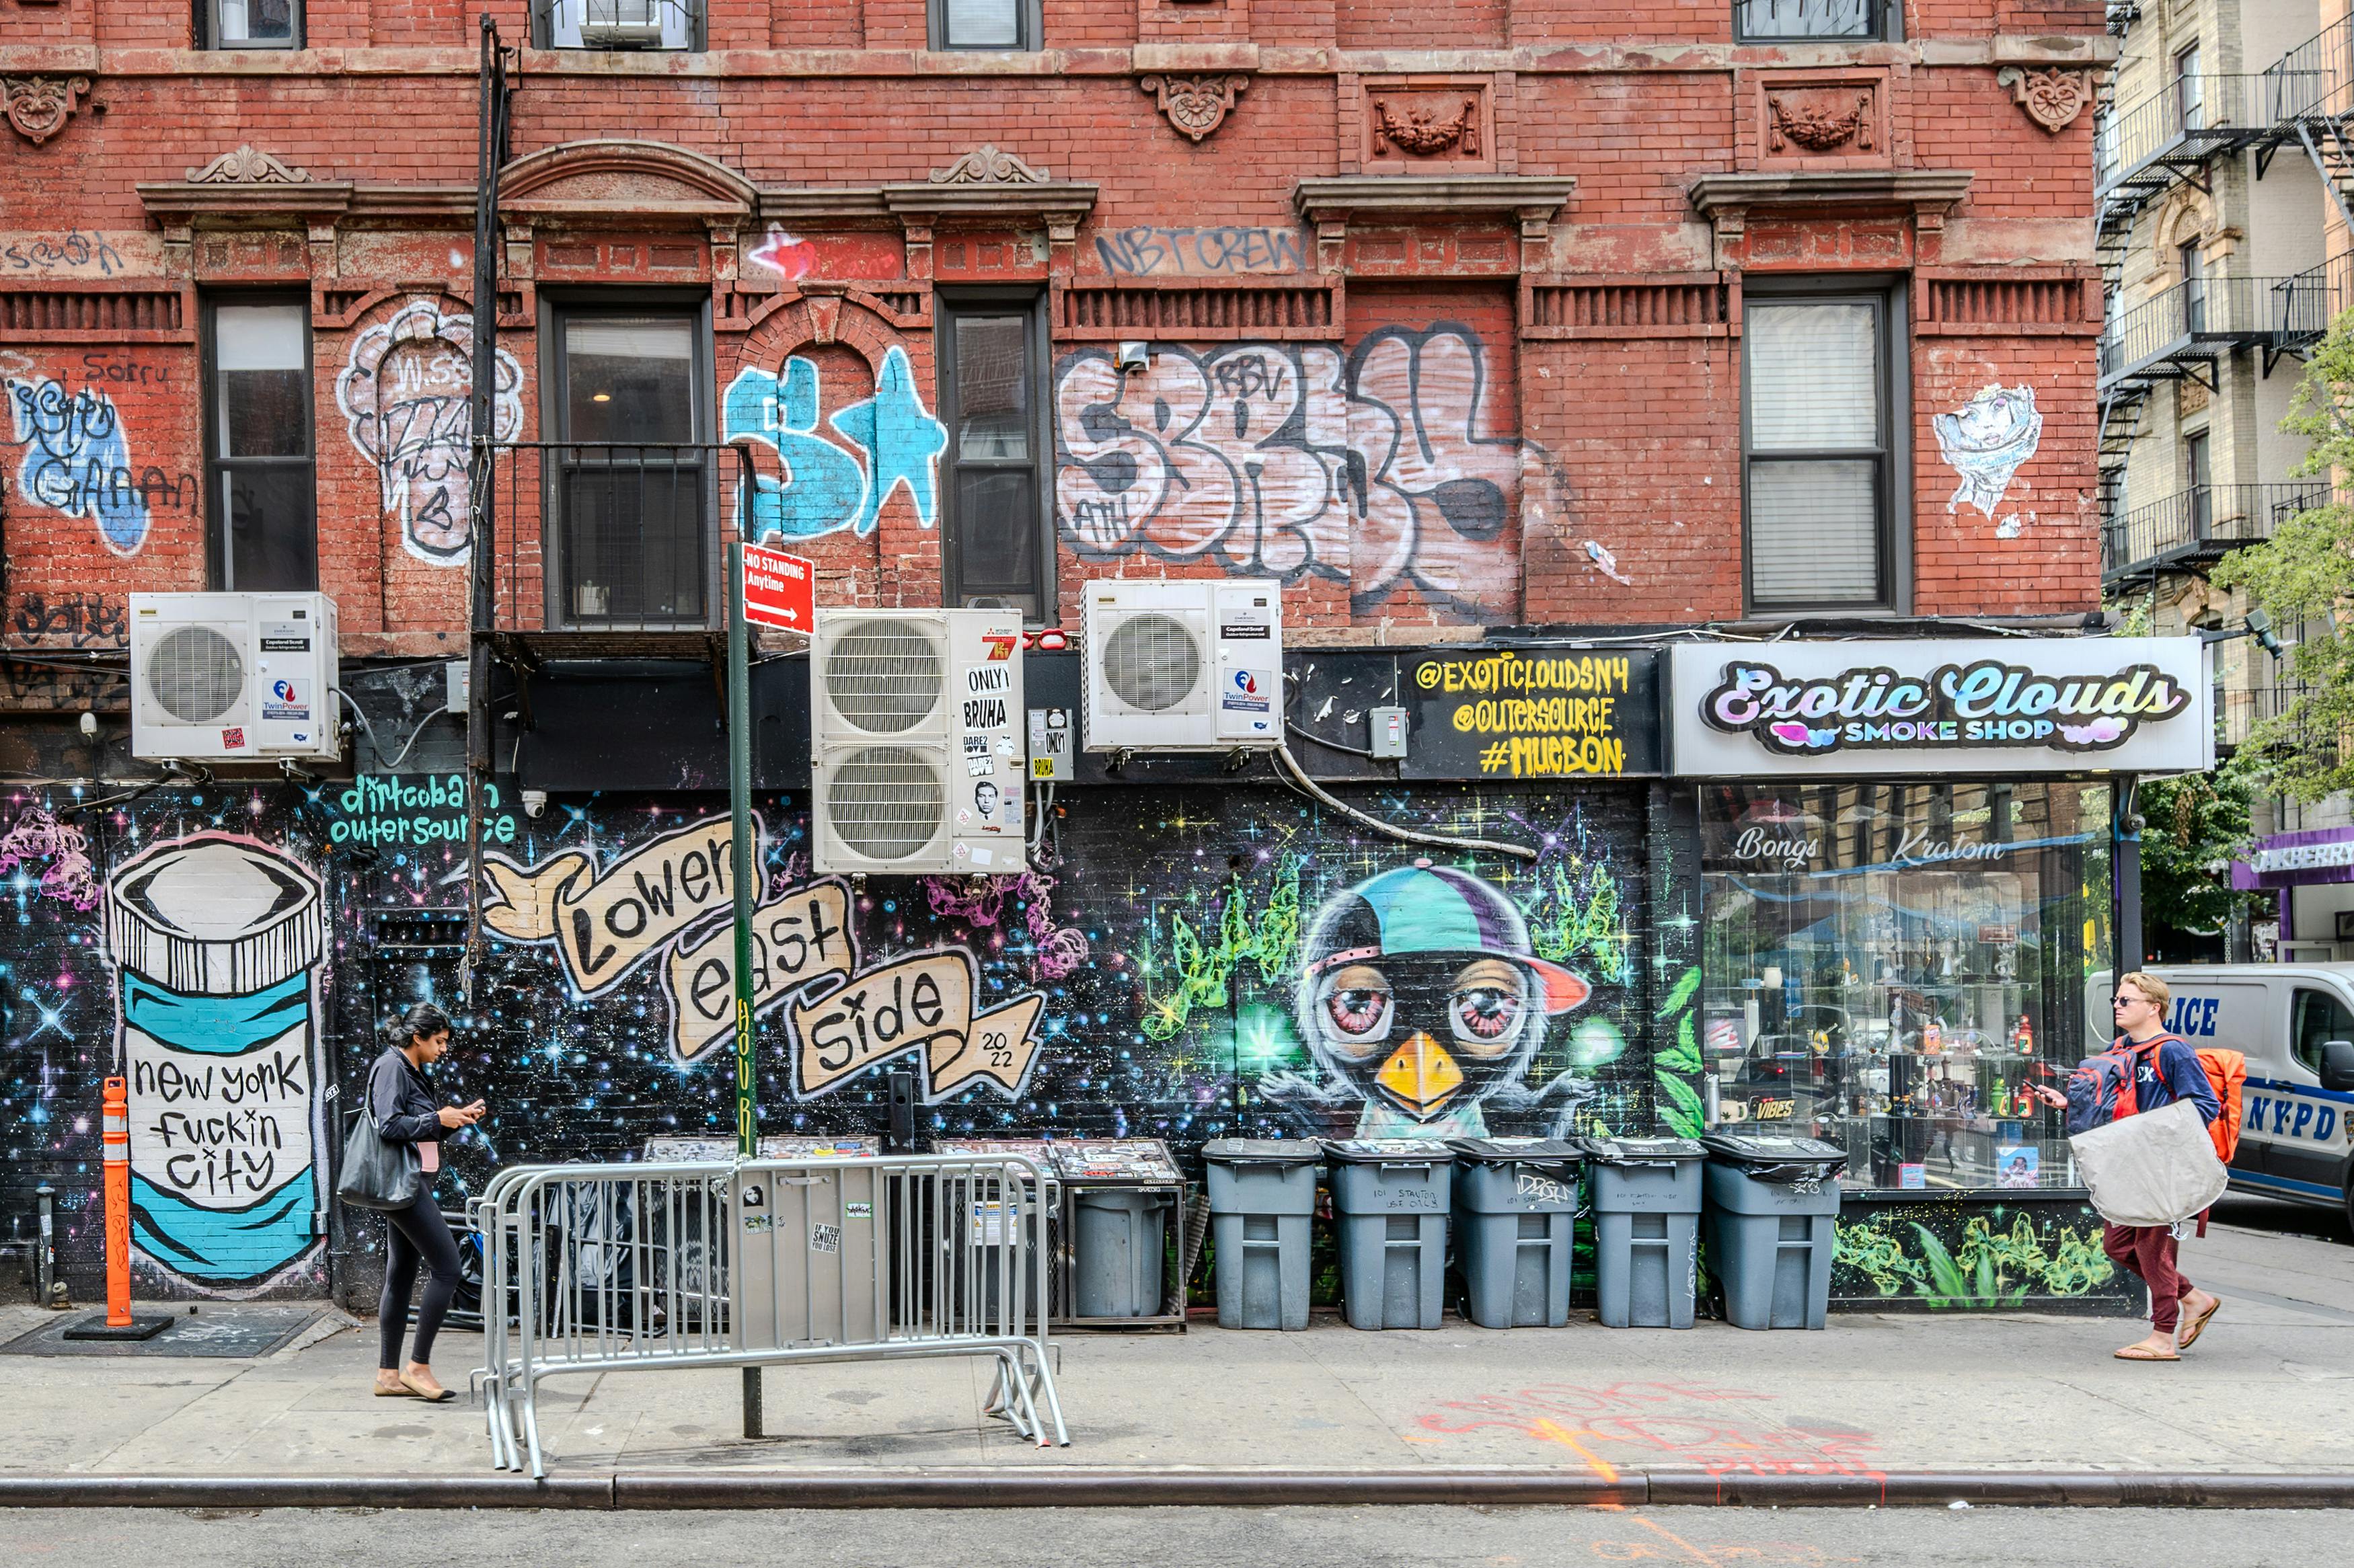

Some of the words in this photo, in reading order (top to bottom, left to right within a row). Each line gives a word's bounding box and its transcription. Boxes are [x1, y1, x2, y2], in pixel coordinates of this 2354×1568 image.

[1096, 224, 1195, 276] NBT
[1195, 229, 1307, 274] CREW
[746, 553, 760, 569] NO
[761, 557, 804, 580] STANDING
[747, 571, 785, 592] Anytime
[264, 702, 308, 710] TwinPower
[1225, 692, 1269, 702] TwinPower
[1715, 666, 1930, 724] Exotic
[1940, 666, 2183, 718] Clouds
[963, 699, 1007, 729] BRUHA
[963, 736, 988, 745] DARE2
[1844, 719, 1958, 741] SMOKE
[1965, 719, 2054, 740] SHOP
[967, 755, 993, 768] DARE2
[1034, 758, 1054, 776] BRUHA
[340, 774, 499, 815] dirtcoban
[1735, 826, 1819, 868] Bongs
[1891, 826, 2005, 866] Kratom
[572, 838, 733, 975] Lower
[691, 900, 839, 1021] east
[811, 972, 944, 1072] side
[982, 1032, 1008, 1051] 20
[991, 1051, 1013, 1068] 22
[135, 1059, 213, 1103] new
[221, 1051, 304, 1104] york
[738, 998, 751, 1154] HOUR
[1756, 1099, 1796, 1120] VIBES
[2247, 1096, 2336, 1141] NYPD
[149, 1109, 281, 1150] fuckin
[166, 1148, 274, 1195] city
[812, 1231, 839, 1245] SNUZE
[814, 1224, 824, 1232] IF
[824, 1225, 840, 1235] YOU
[812, 1242, 823, 1250] YOU
[823, 1243, 837, 1253] LOSE
